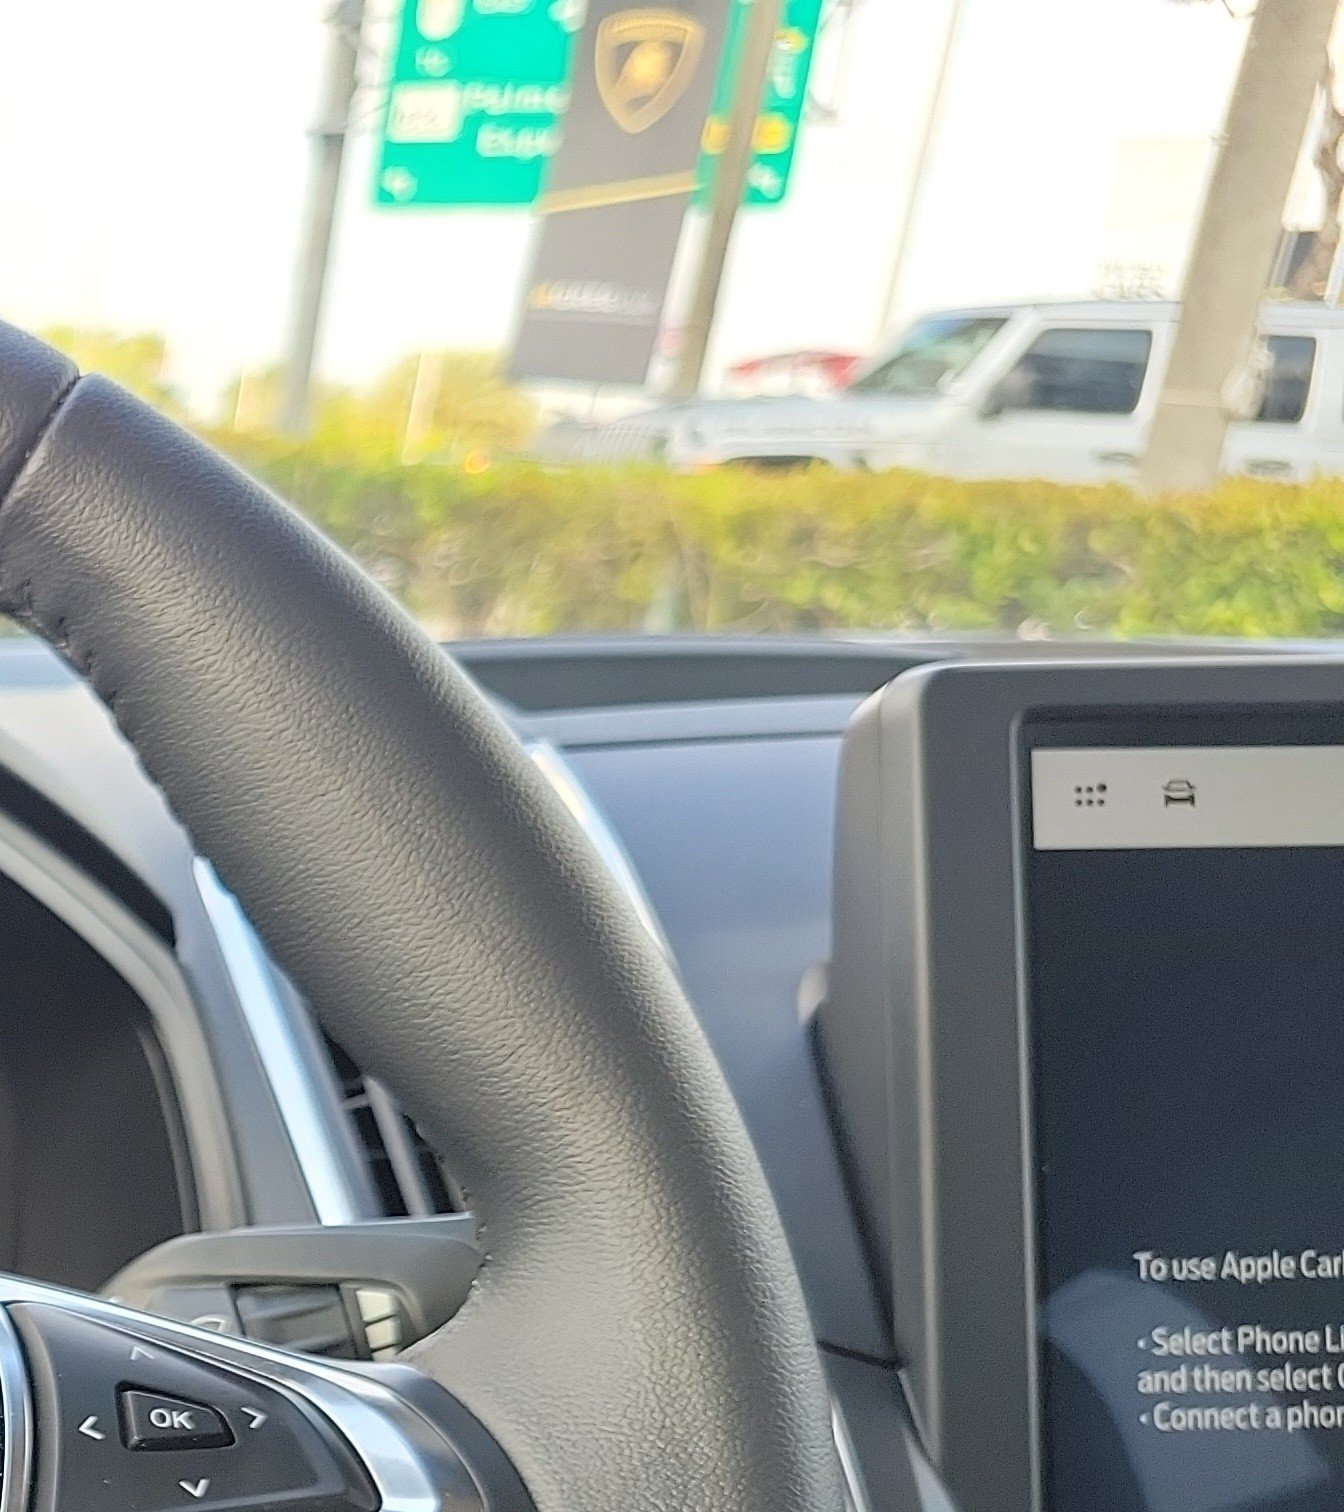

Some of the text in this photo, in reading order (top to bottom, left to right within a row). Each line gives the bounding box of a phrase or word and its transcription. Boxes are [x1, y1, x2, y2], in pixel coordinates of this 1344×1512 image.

[1133, 1249, 1344, 1284] To use Apple Car
[1151, 1325, 1232, 1356] Select
[1237, 1324, 1320, 1355] Phone
[1138, 1364, 1187, 1394] and
[1193, 1363, 1253, 1392] then
[1257, 1361, 1332, 1391] select
[150, 1406, 194, 1430] OK
[1153, 1401, 1260, 1432] Connect
[1265, 1406, 1281, 1429] a
